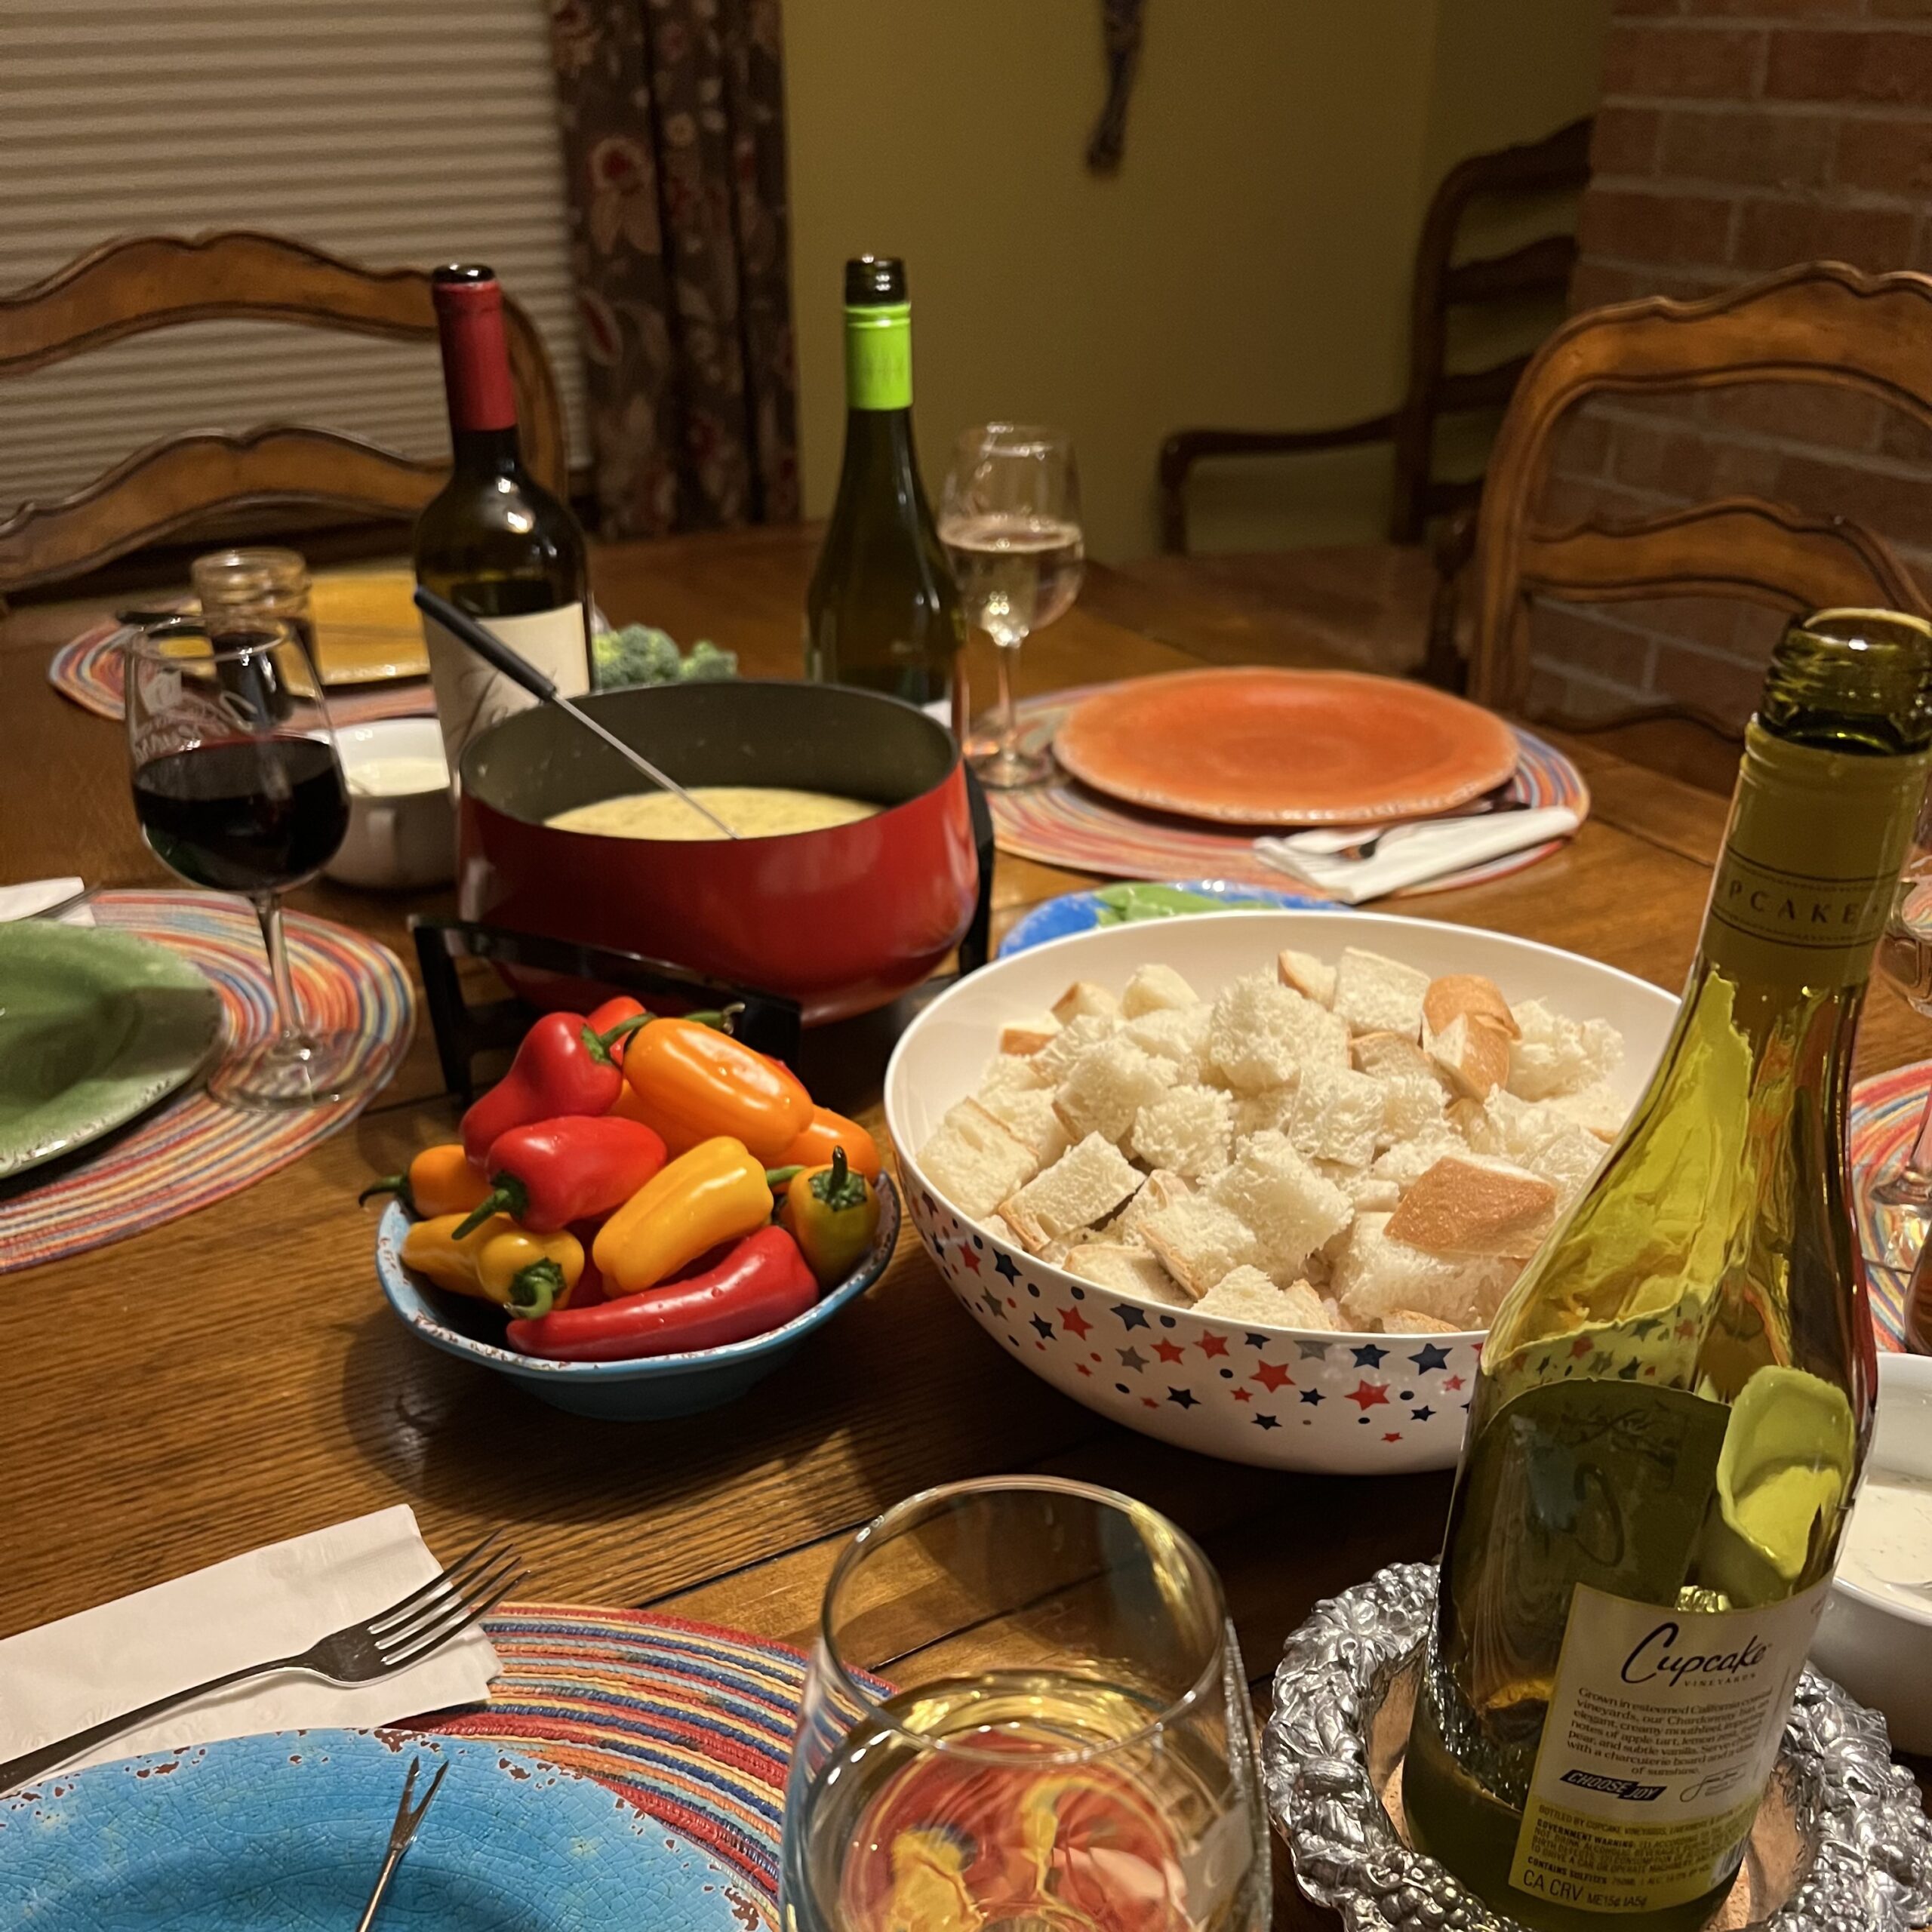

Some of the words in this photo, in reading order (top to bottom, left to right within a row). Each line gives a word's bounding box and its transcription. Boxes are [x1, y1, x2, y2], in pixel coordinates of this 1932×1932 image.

[1621, 1622, 1767, 1687] Cupcake
[1684, 1672, 1756, 1687] VINEYARDS
[1579, 1687, 1617, 1706] Grown
[1620, 1699, 1630, 1709] in
[1577, 1699, 1639, 1722] vineyards,
[1643, 1715, 1664, 1724] our
[1571, 1719, 1603, 1736] notes
[1606, 1730, 1619, 1739] of
[1567, 1740, 1592, 1755] with
[1599, 1740, 1621, 1751] and
[1631, 1765, 1646, 1775] of
[1567, 1772, 1632, 1793] CHOOSE
[1623, 1787, 1660, 1799] JOY
[1534, 1826, 1551, 1840] NOT
[1537, 1818, 1592, 1842] GOVERNMENT
[1533, 1835, 1557, 1849] BIRTH
[1527, 1856, 1567, 1875] CONTAINS
[1569, 1855, 1575, 1865] A
[1523, 1869, 1545, 1892] CA
[1549, 1878, 1584, 1901] CRV
